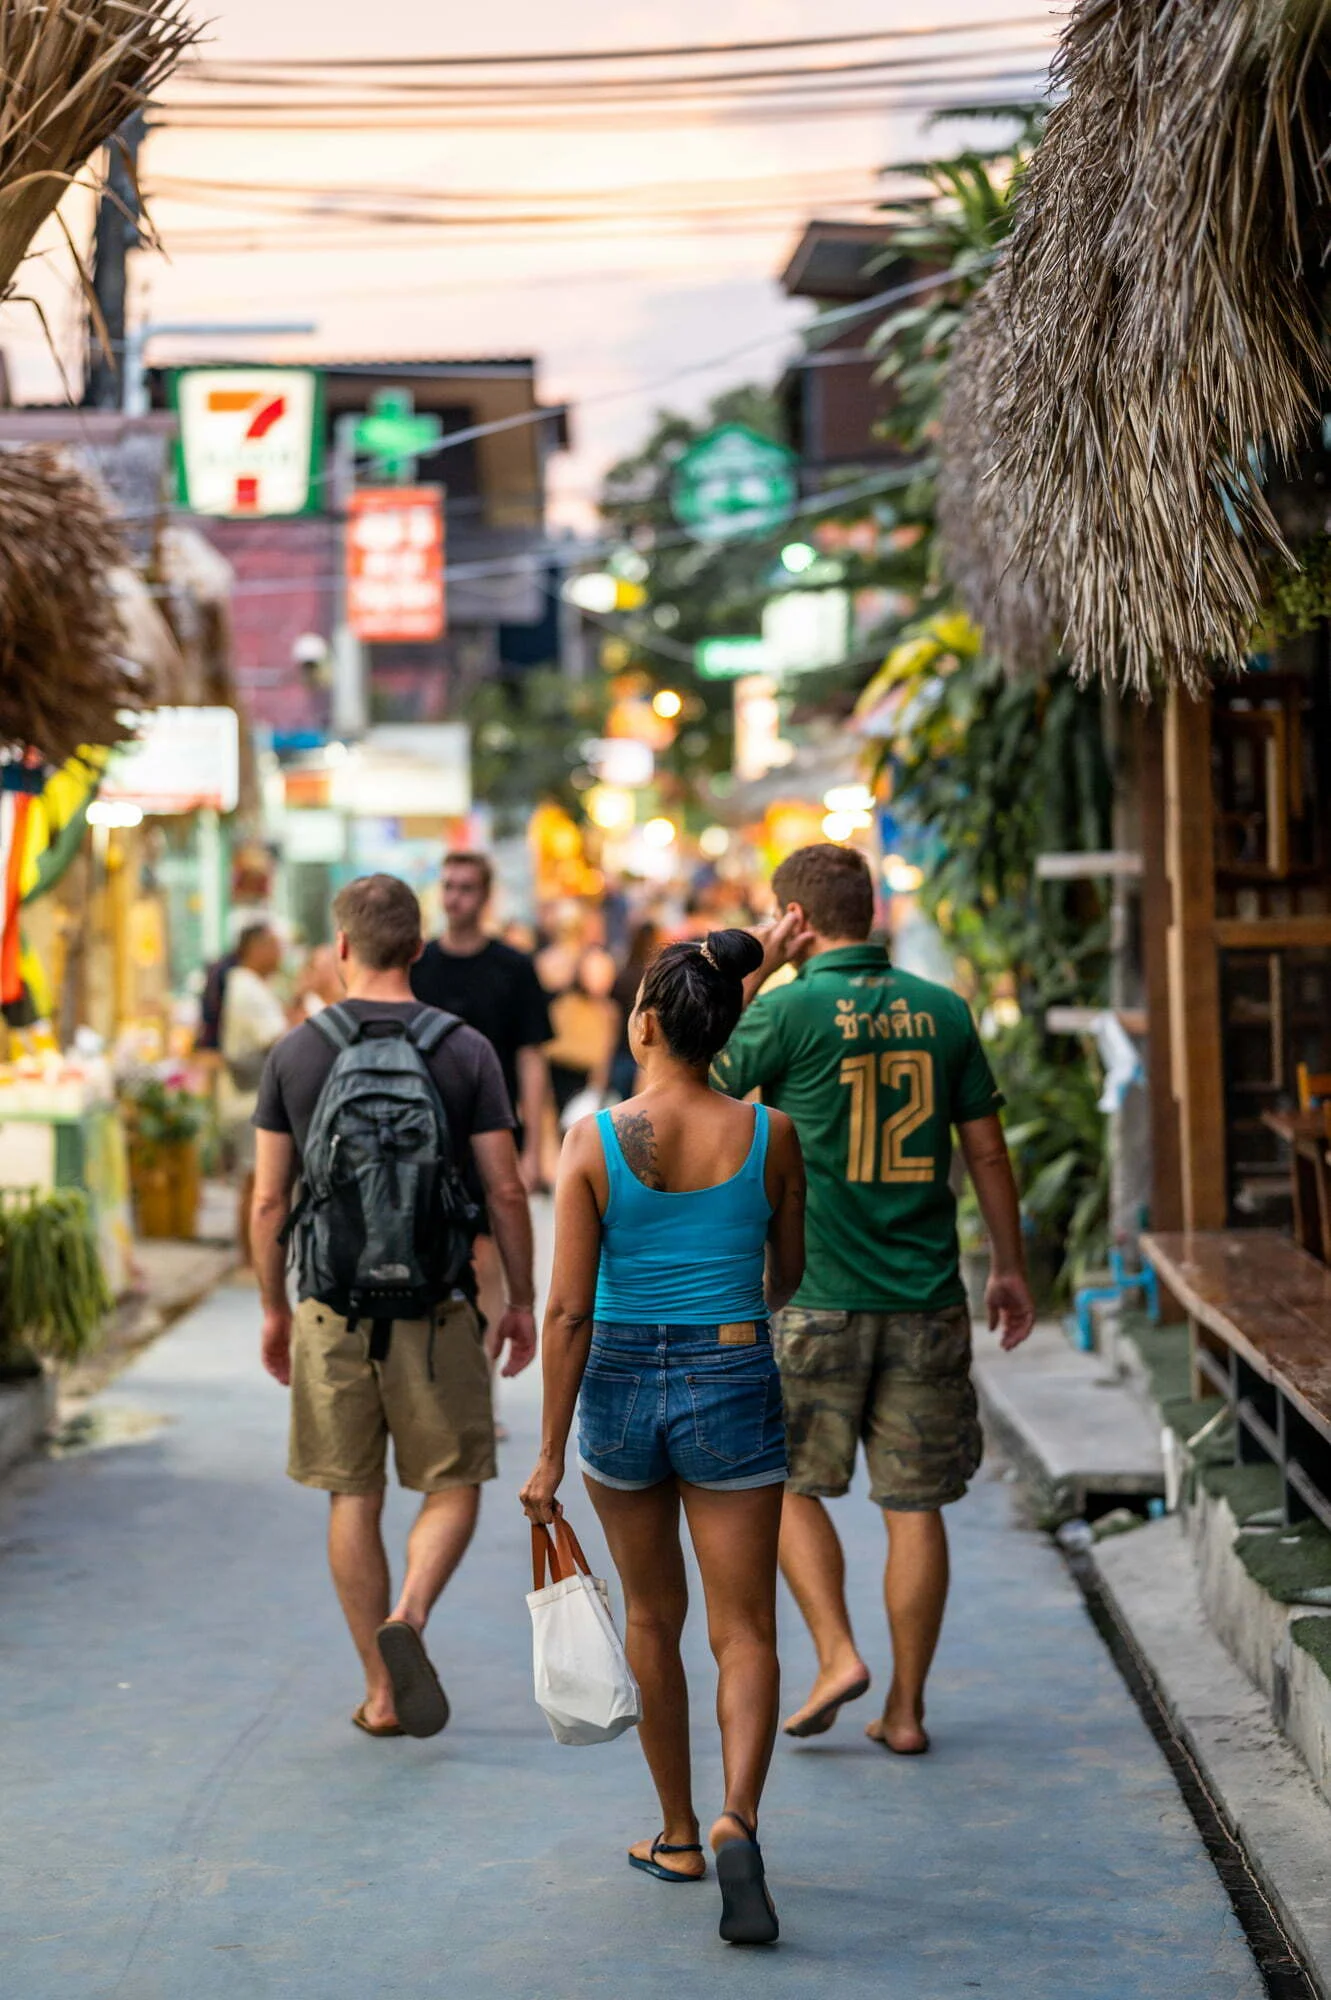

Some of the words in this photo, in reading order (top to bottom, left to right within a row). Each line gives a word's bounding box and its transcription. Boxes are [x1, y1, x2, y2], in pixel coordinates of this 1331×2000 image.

[207, 390, 286, 507] 7
[834, 997, 936, 1040] ช้างศึก
[839, 1050, 935, 1183] 12
